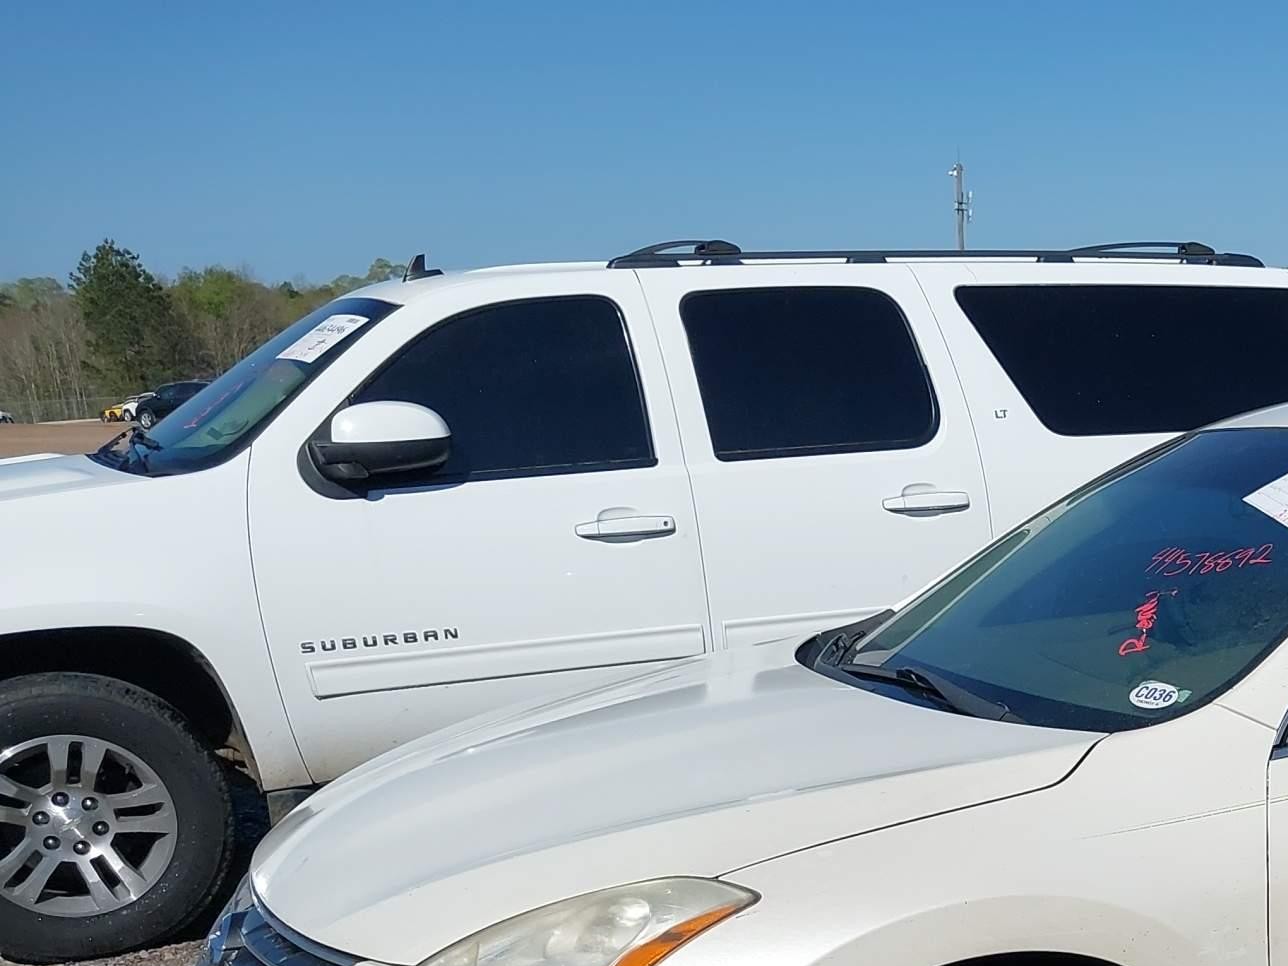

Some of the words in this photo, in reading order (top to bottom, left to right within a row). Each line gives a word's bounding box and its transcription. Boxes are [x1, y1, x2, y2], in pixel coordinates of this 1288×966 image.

[994, 409, 1008, 419] LT
[300, 627, 459, 654] SUBURBAN
[1135, 686, 1176, 703] C036
